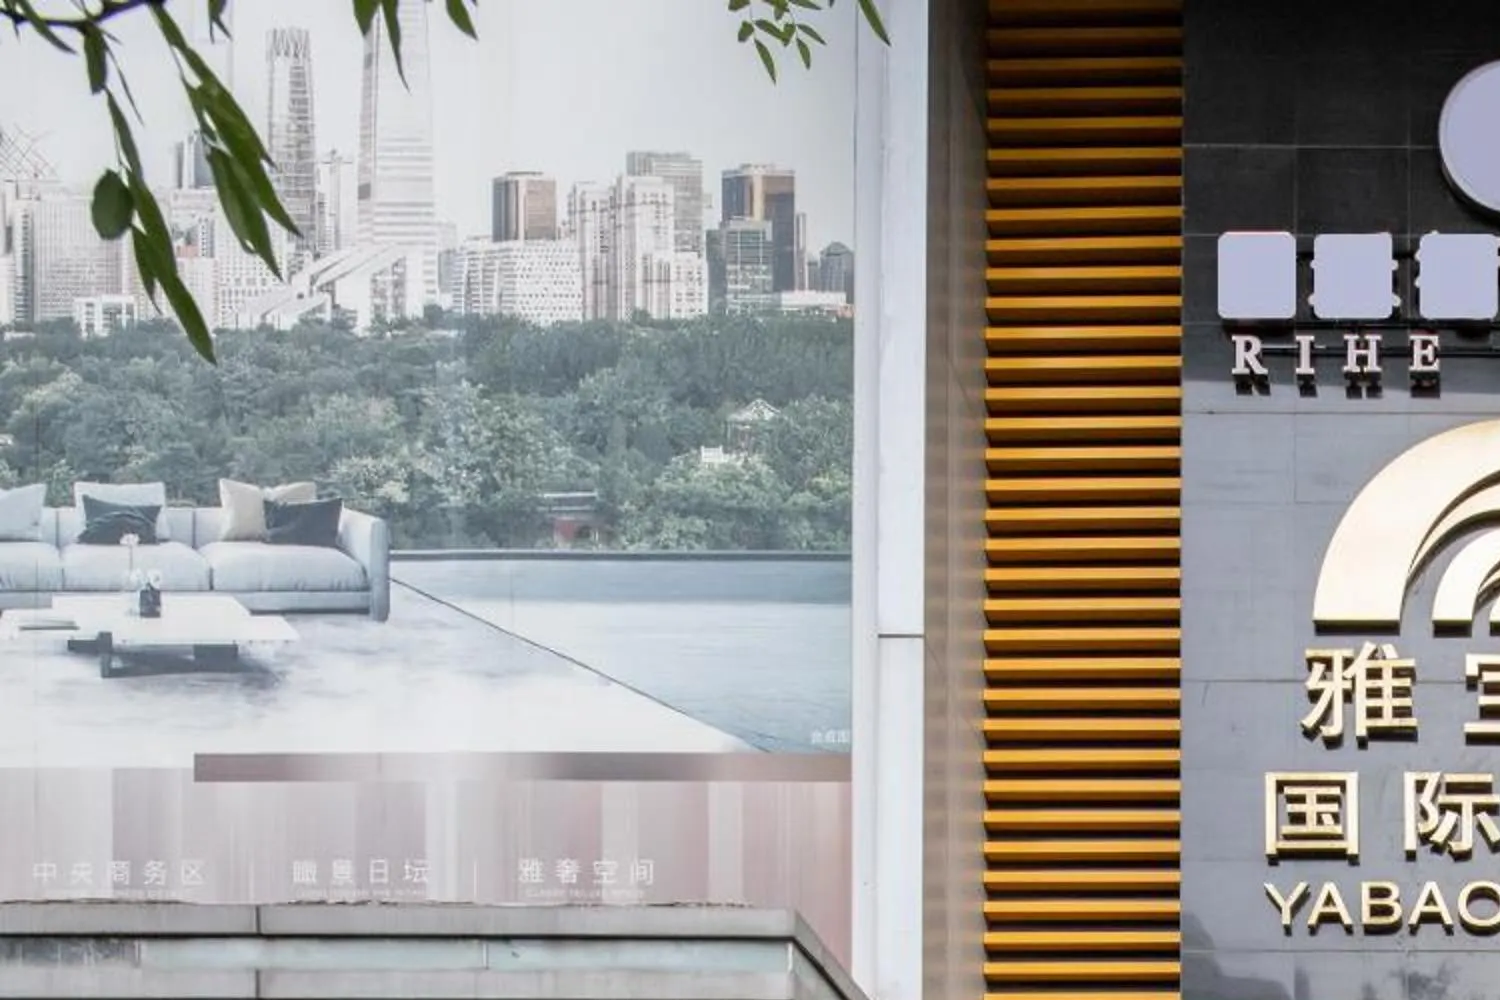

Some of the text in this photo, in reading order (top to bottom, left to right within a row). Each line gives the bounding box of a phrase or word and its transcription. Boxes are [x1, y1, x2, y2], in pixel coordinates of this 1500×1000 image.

[1231, 334, 1441, 376] RIHE
[33, 860, 205, 887] 中央商务区
